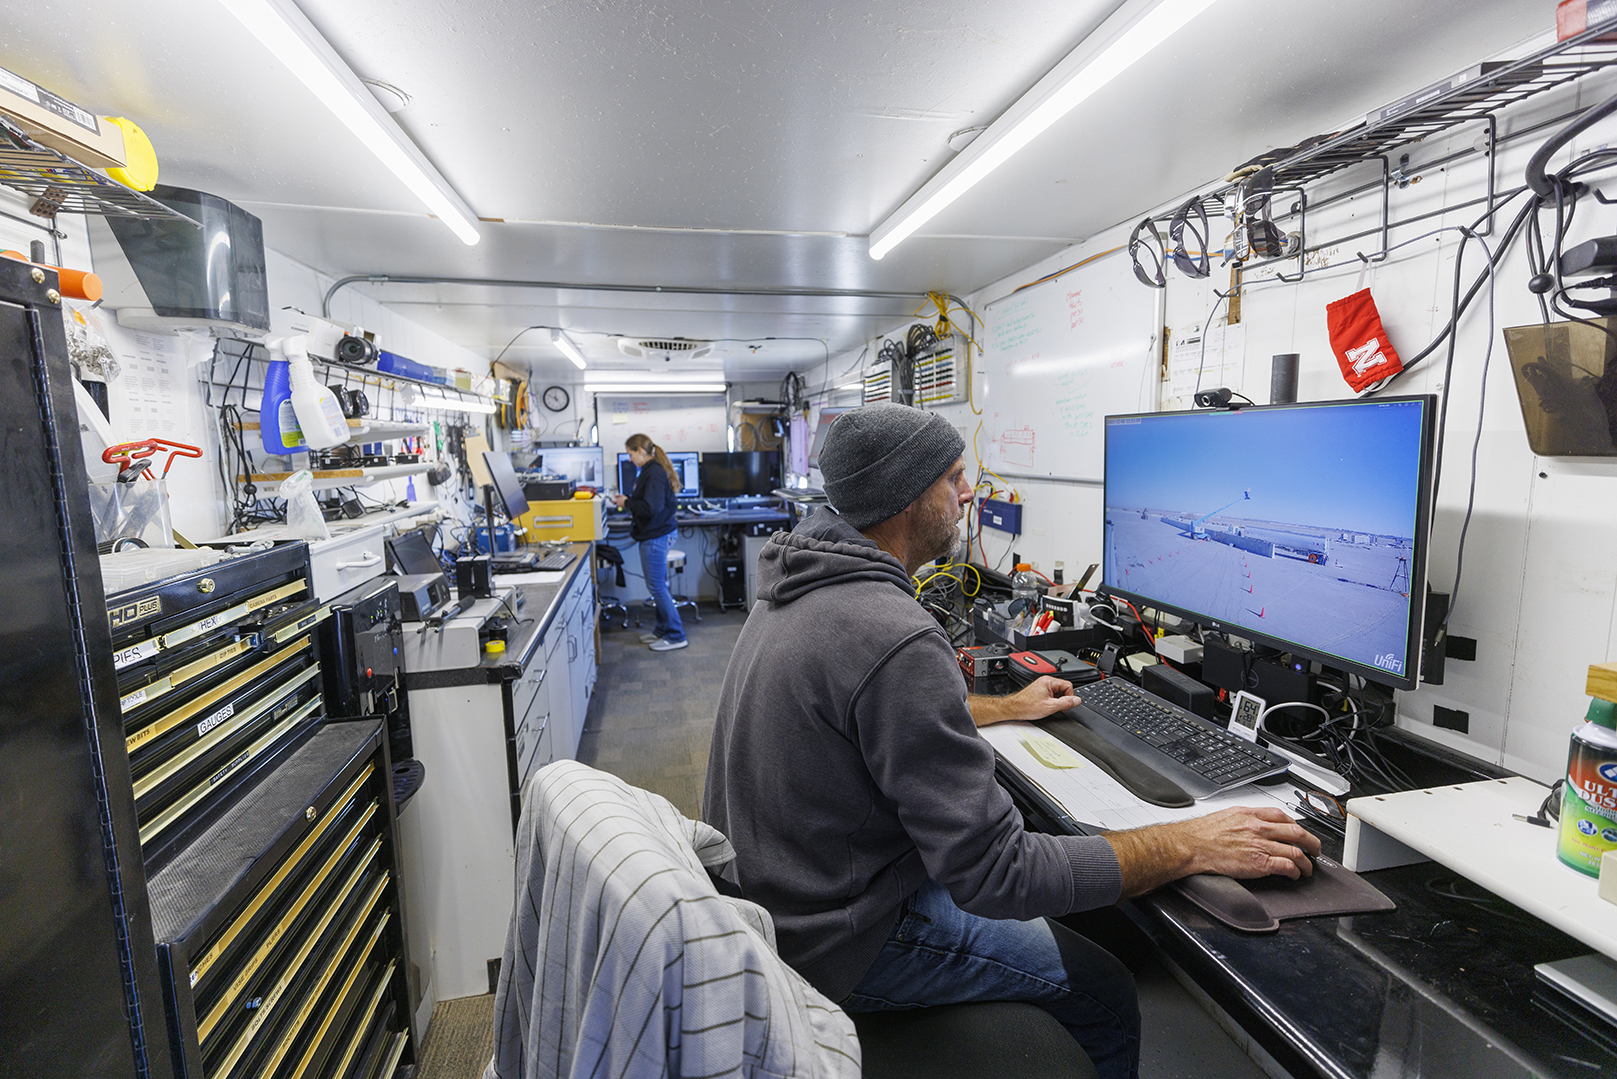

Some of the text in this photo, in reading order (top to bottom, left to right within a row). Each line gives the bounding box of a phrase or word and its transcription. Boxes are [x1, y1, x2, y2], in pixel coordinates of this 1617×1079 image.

[1345, 337, 1387, 377] N
[109, 601, 158, 627] HD PLUS
[249, 594, 277, 608] CAMERA PARTS
[200, 617, 216, 630] HEX
[1374, 654, 1402, 672] UniFi
[127, 692, 143, 703] TOOLS
[200, 705, 233, 733] GAUGES
[137, 729, 150, 739] BITS
[213, 752, 249, 782] SAFETY SUPPLIES
[190, 952, 213, 983] ENCHES
[233, 928, 281, 991] VISE GRIPS PLIERS
